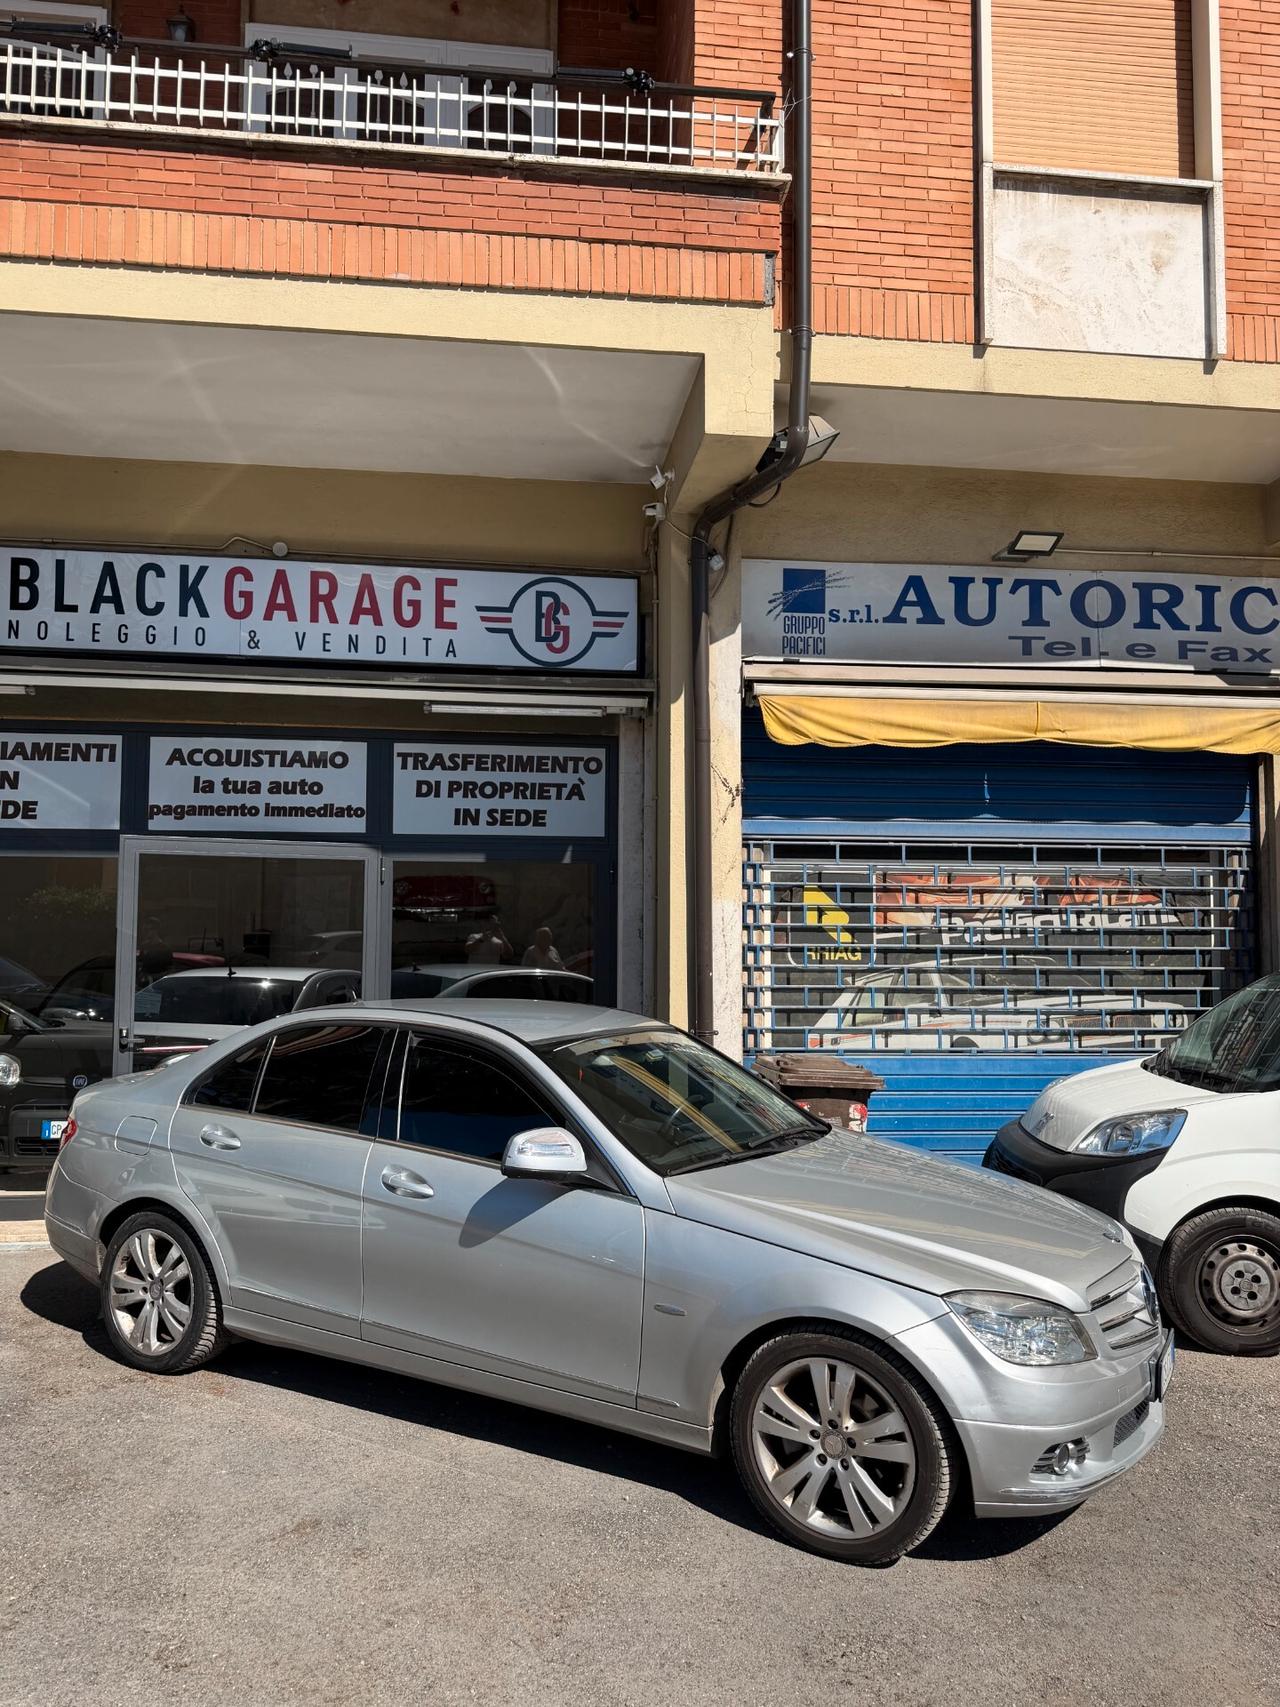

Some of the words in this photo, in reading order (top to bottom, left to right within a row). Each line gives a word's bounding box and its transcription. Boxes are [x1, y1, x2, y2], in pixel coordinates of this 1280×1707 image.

[882, 575, 1280, 636] AUTORIC
[783, 615, 825, 635] GRUPPO
[8, 619, 207, 648] NOLEGGIO
[247, 630, 261, 649] &
[295, 631, 458, 658] VENDITA
[782, 636, 826, 655] PACIFICI
[1126, 643, 1157, 659] e
[1177, 641, 1273, 664] Fax
[165, 748, 349, 769] ACQUISTIAMO
[397, 752, 603, 775] TRASFERIMENTO
[193, 776, 214, 793] la
[221, 777, 261, 795] tua
[267, 776, 324, 795] auto
[415, 780, 441, 798] DI
[447, 777, 586, 801] PROPRIETÀ
[0, 800, 39, 820] DE
[149, 804, 260, 820] pagamento
[453, 808, 481, 826] IN
[486, 808, 547, 827] SEDE
